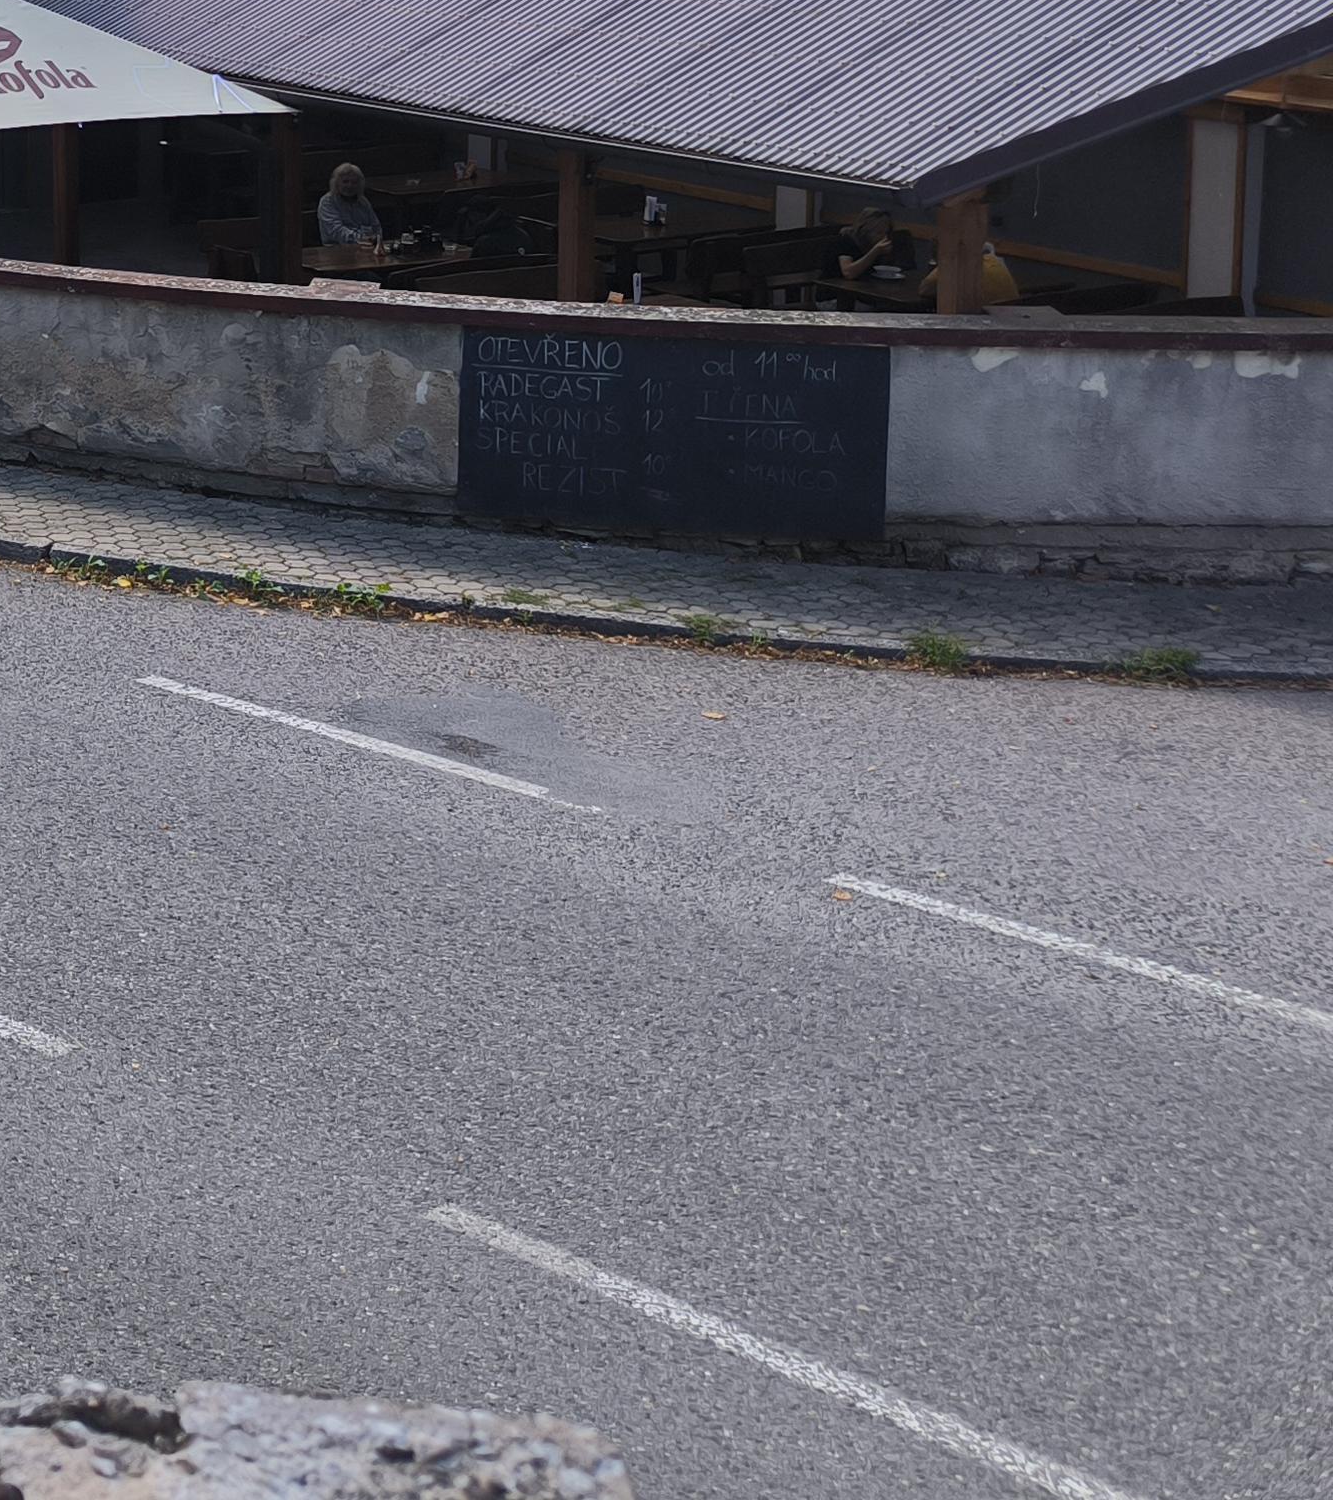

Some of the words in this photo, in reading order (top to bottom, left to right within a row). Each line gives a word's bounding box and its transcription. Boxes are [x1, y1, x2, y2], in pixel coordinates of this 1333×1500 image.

[478, 333, 623, 370] OTEVŘENO
[702, 350, 735, 376] od
[477, 371, 611, 402] RADEGAST
[479, 400, 621, 435] KRAKONOŠ
[745, 427, 847, 456] KOFOLA
